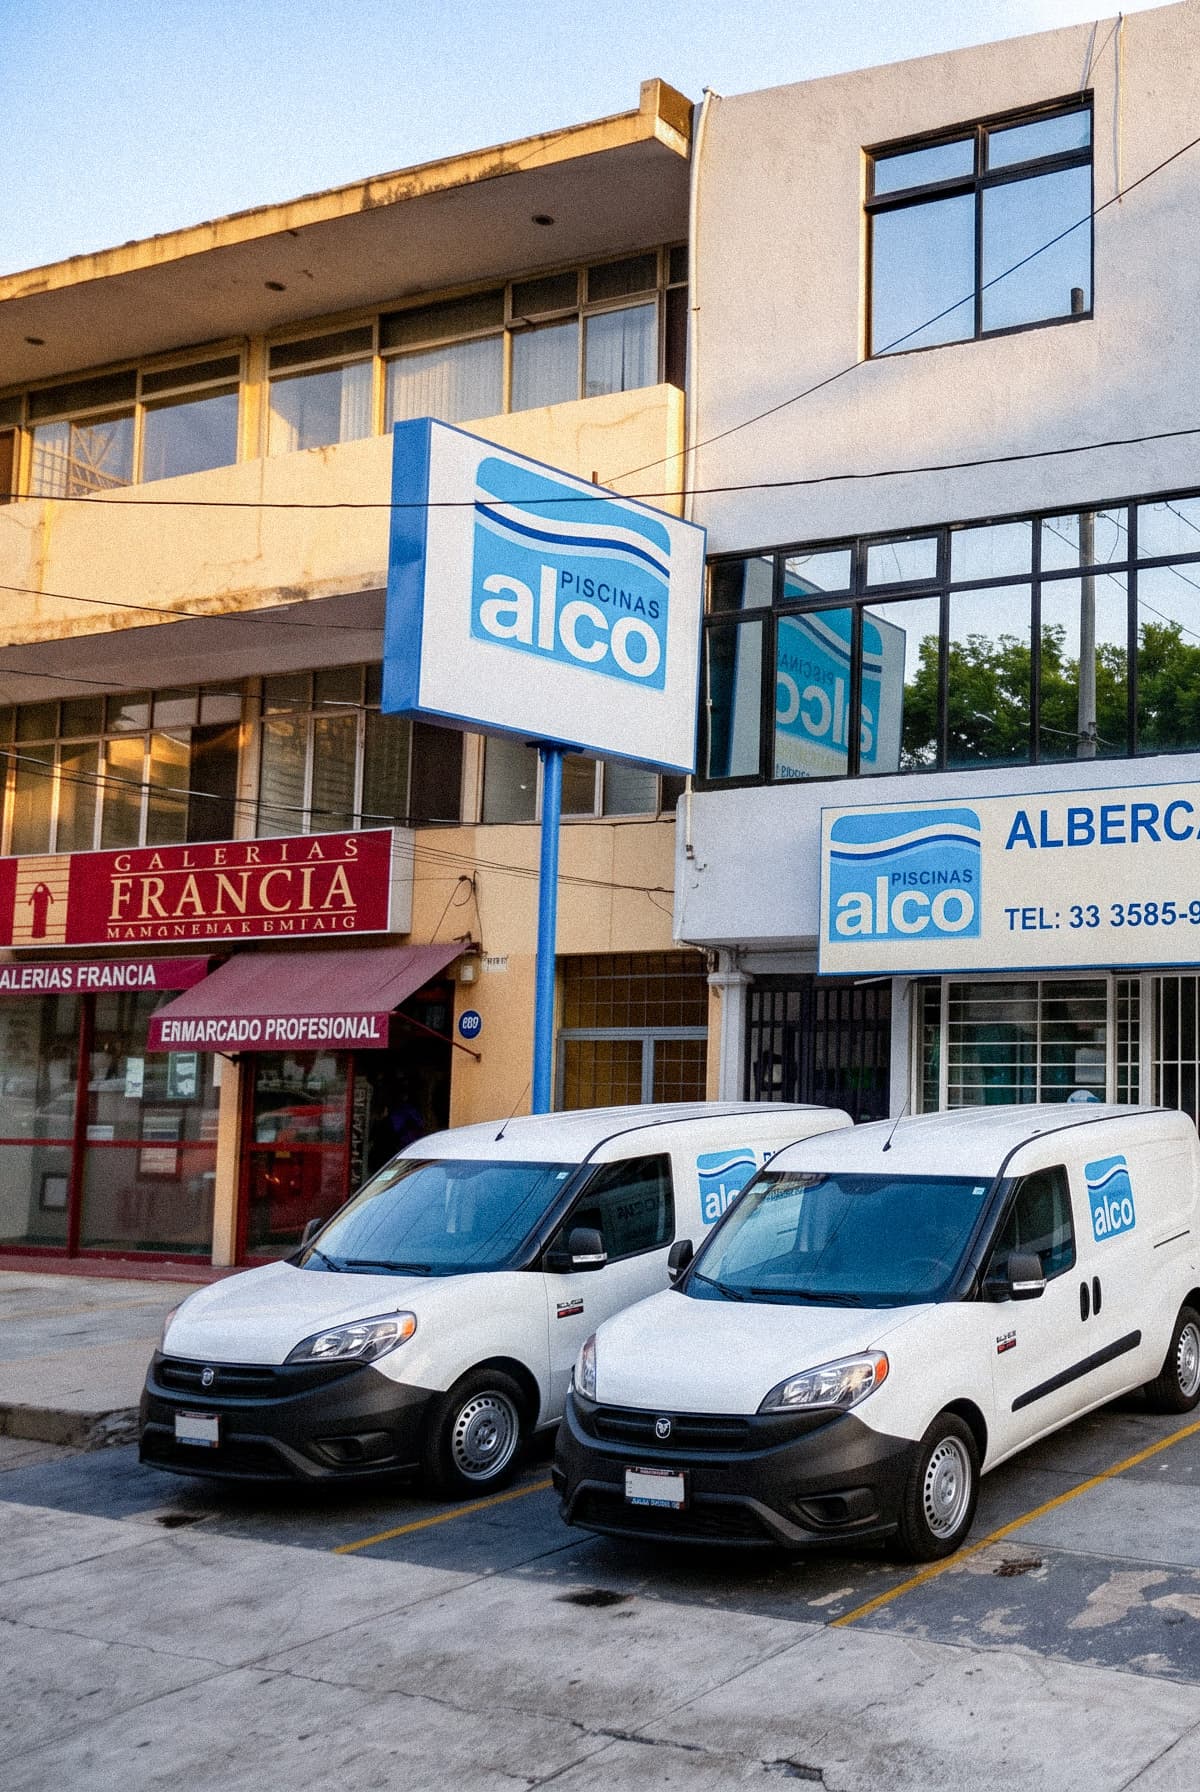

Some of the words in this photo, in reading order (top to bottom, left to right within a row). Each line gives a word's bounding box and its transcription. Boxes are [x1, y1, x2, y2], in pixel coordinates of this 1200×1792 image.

[561, 571, 661, 620] PISCINAS
[479, 564, 662, 678] alco
[114, 838, 359, 873] GALERIAS
[108, 864, 358, 920] FRANCIA
[891, 868, 974, 886] PISCINAS
[835, 876, 975, 936] alco
[1005, 907, 1062, 931] TEL:
[1069, 905, 1101, 929] 33
[76, 965, 157, 987] FRANCIA
[160, 1018, 262, 1042] ENMARCADO
[264, 1016, 381, 1040] PROFESIONAL
[1094, 1195, 1134, 1236] alco
